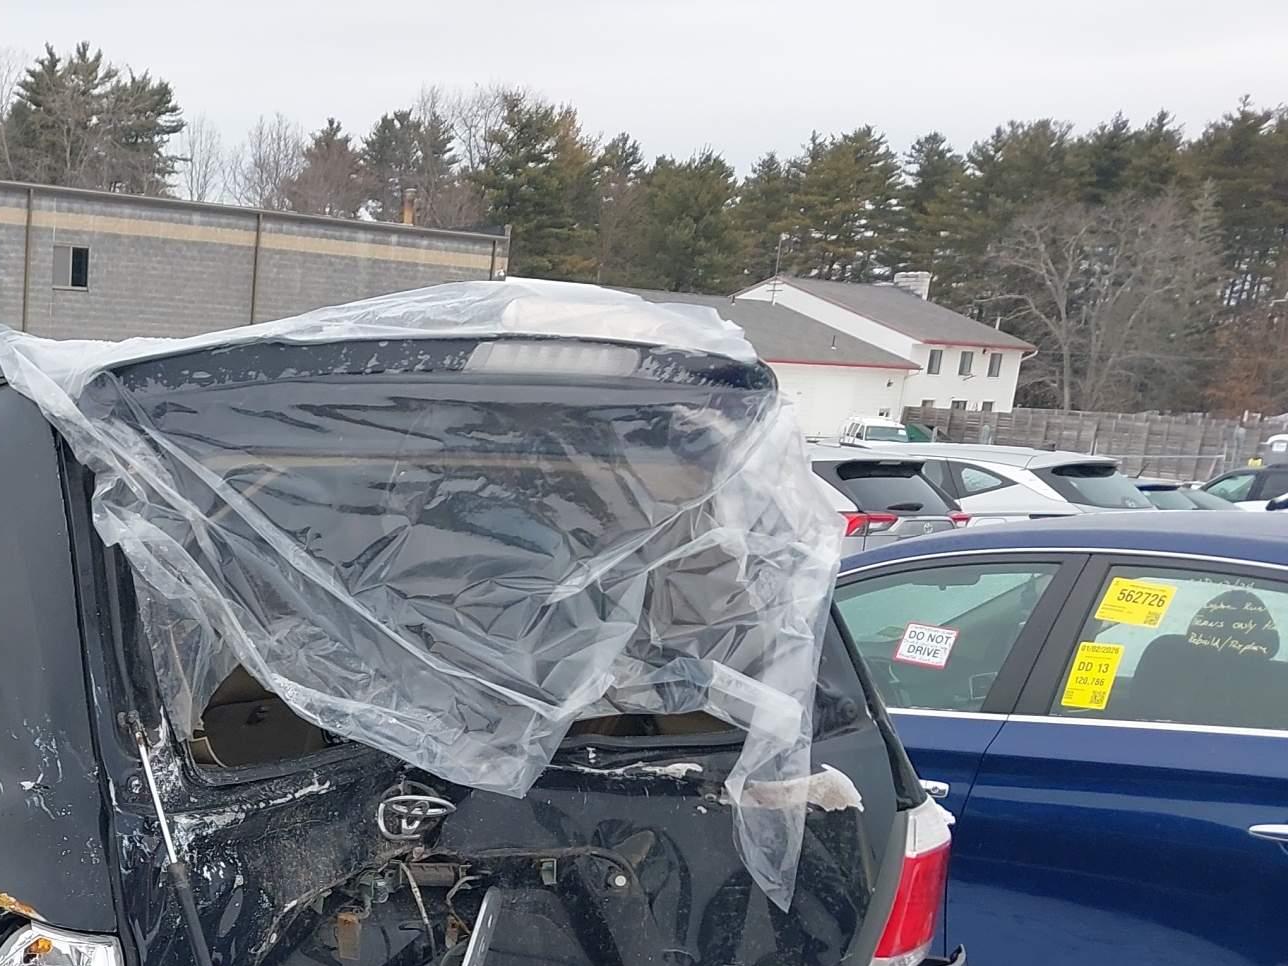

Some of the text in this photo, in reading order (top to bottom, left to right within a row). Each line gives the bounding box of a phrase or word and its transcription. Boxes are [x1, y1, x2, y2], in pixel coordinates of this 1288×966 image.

[1116, 588, 1167, 608] 562726
[909, 630, 925, 641] DO
[927, 633, 952, 645] NOT
[907, 644, 941, 658] DRIVE
[1077, 661, 1110, 674] DD 13
